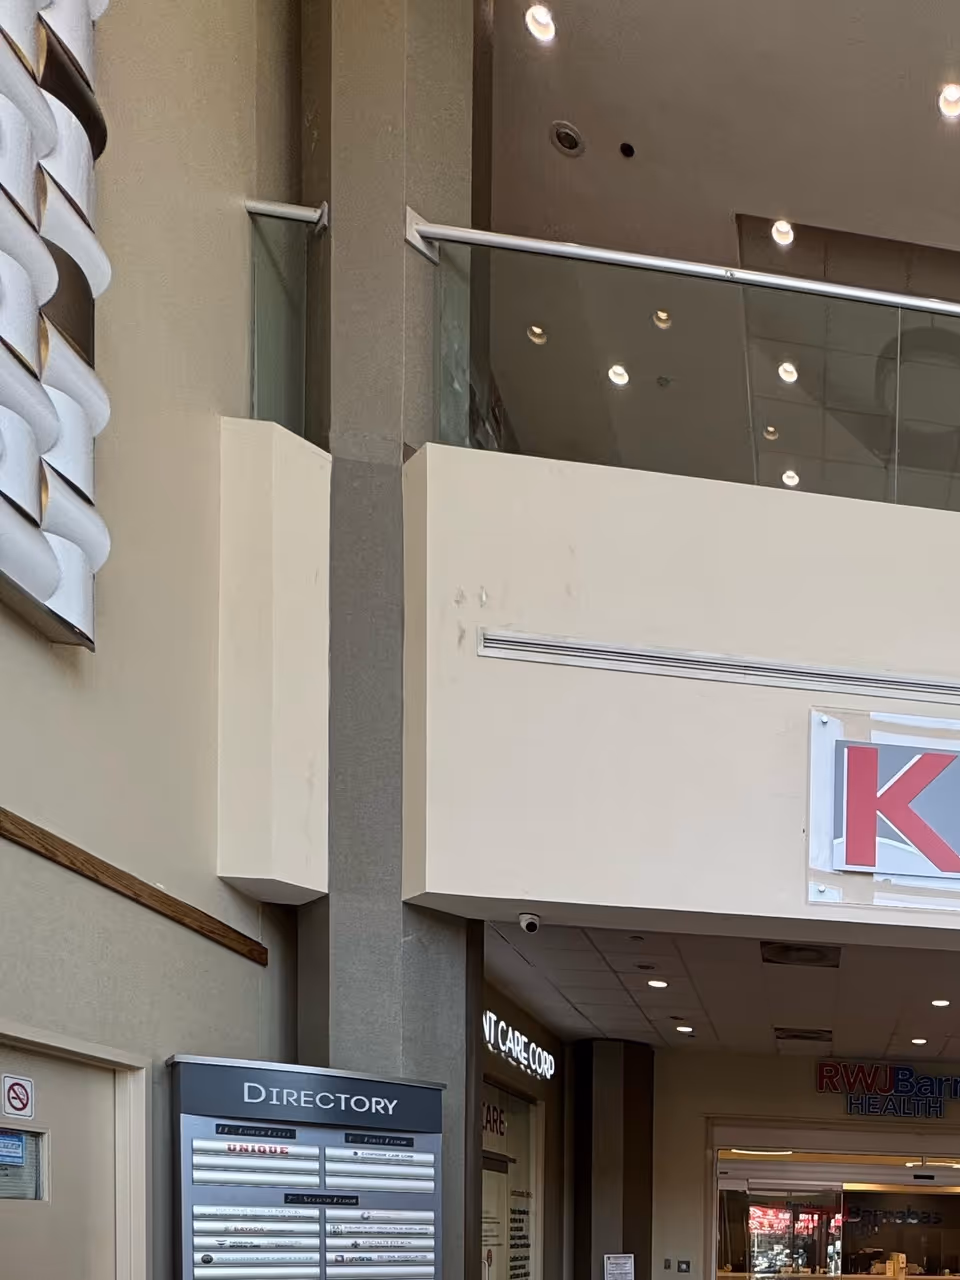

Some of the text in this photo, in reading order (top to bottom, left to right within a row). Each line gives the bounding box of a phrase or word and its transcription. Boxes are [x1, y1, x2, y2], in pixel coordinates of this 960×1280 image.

[498, 1021, 528, 1066] CARE
[529, 1042, 555, 1080] CORP
[243, 1082, 398, 1116] DIRECTORY
[847, 1095, 944, 1118] HEALTH
[227, 1144, 289, 1155] UNIQUE
